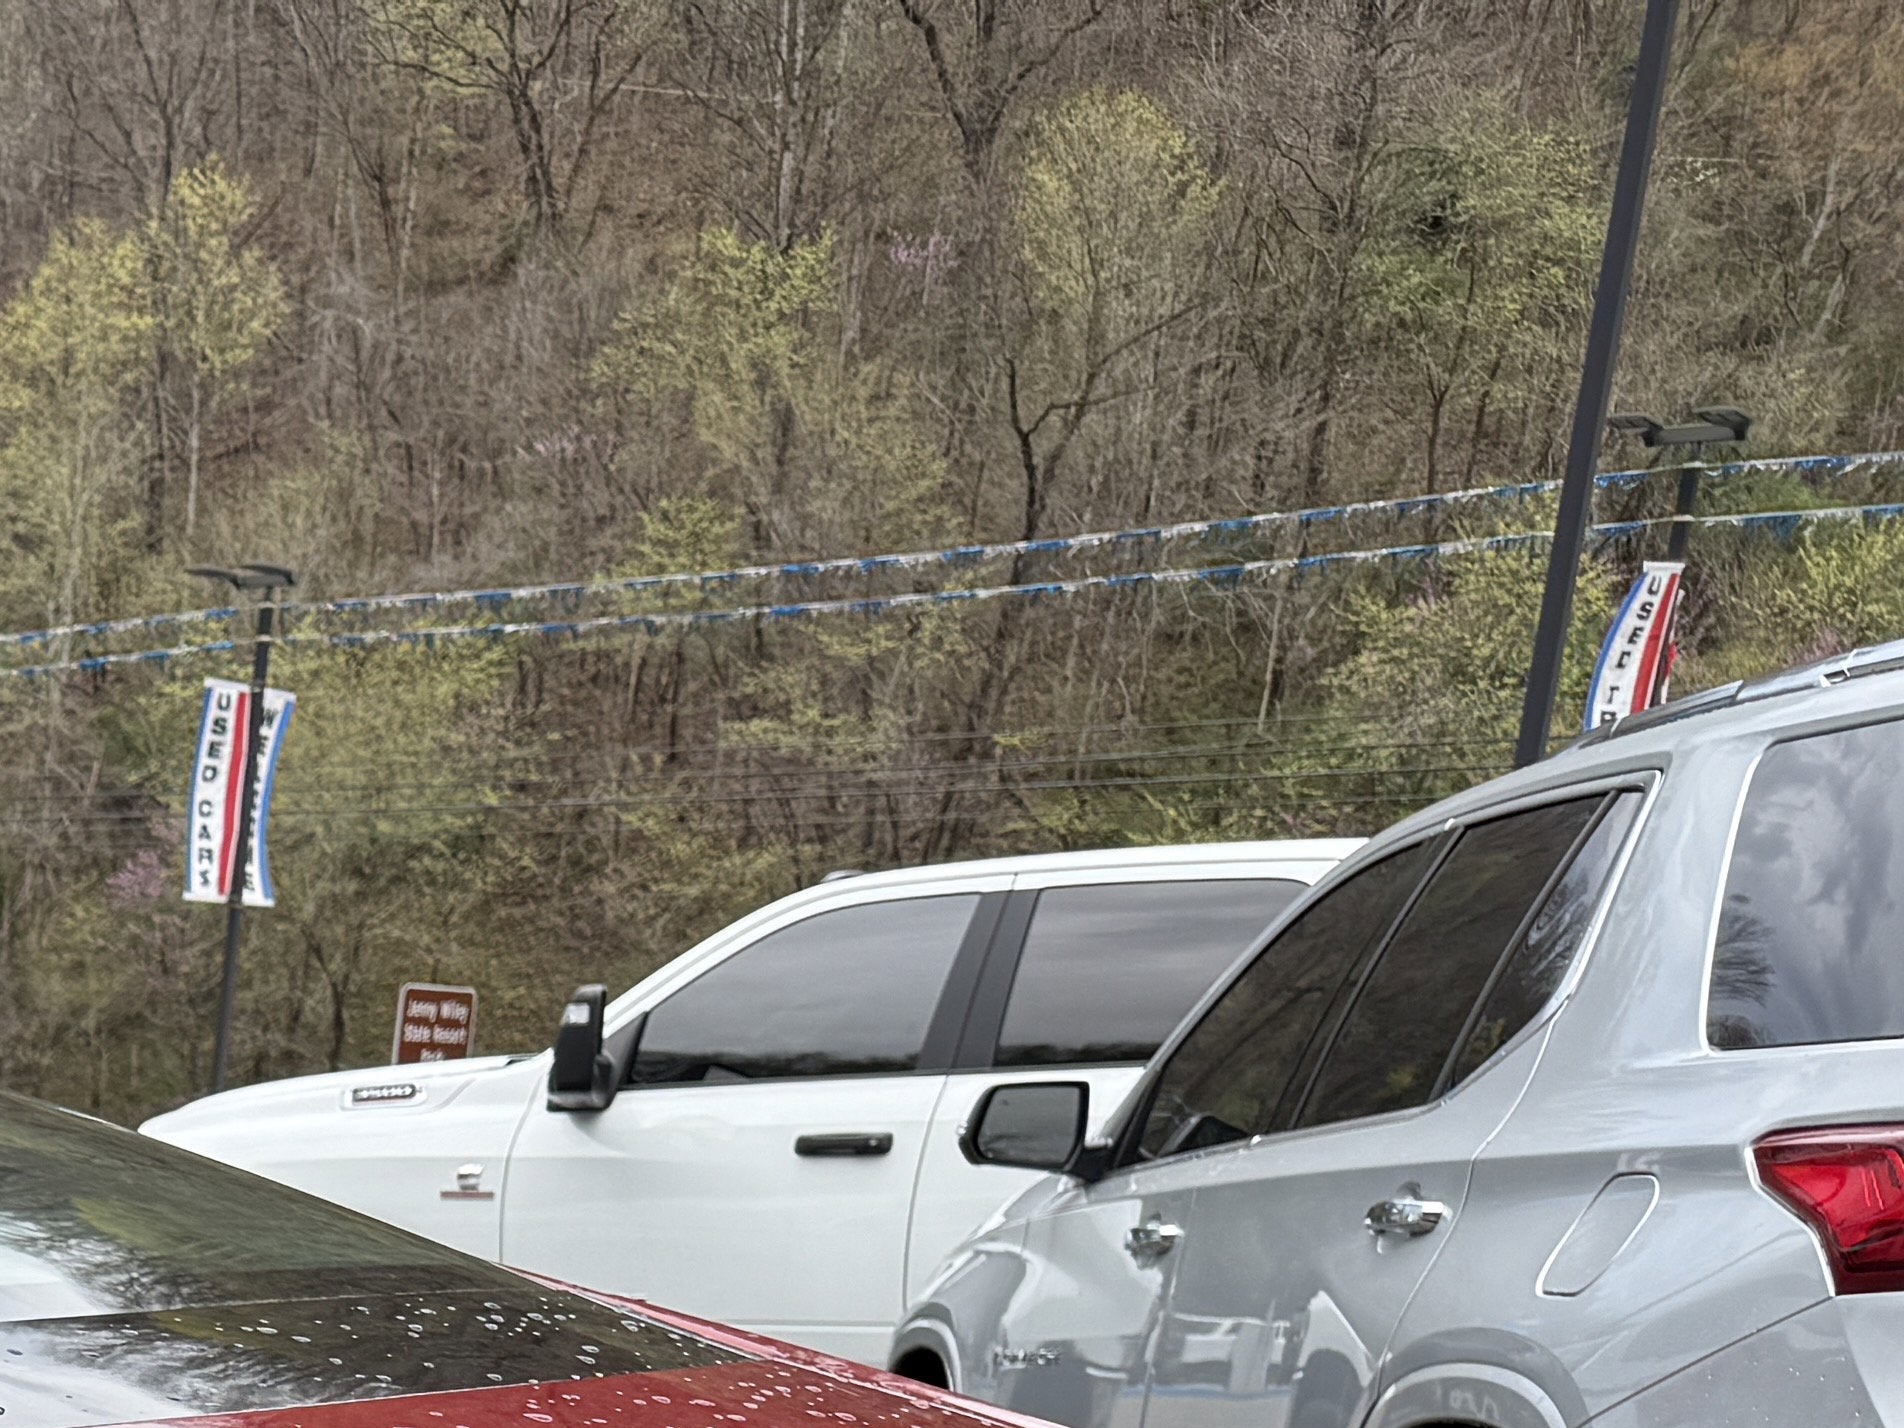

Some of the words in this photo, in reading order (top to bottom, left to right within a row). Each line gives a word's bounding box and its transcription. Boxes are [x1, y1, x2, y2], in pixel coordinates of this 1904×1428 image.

[201, 692, 231, 783] USED
[197, 799, 213, 886] CARS
[404, 1022, 431, 1043] State
